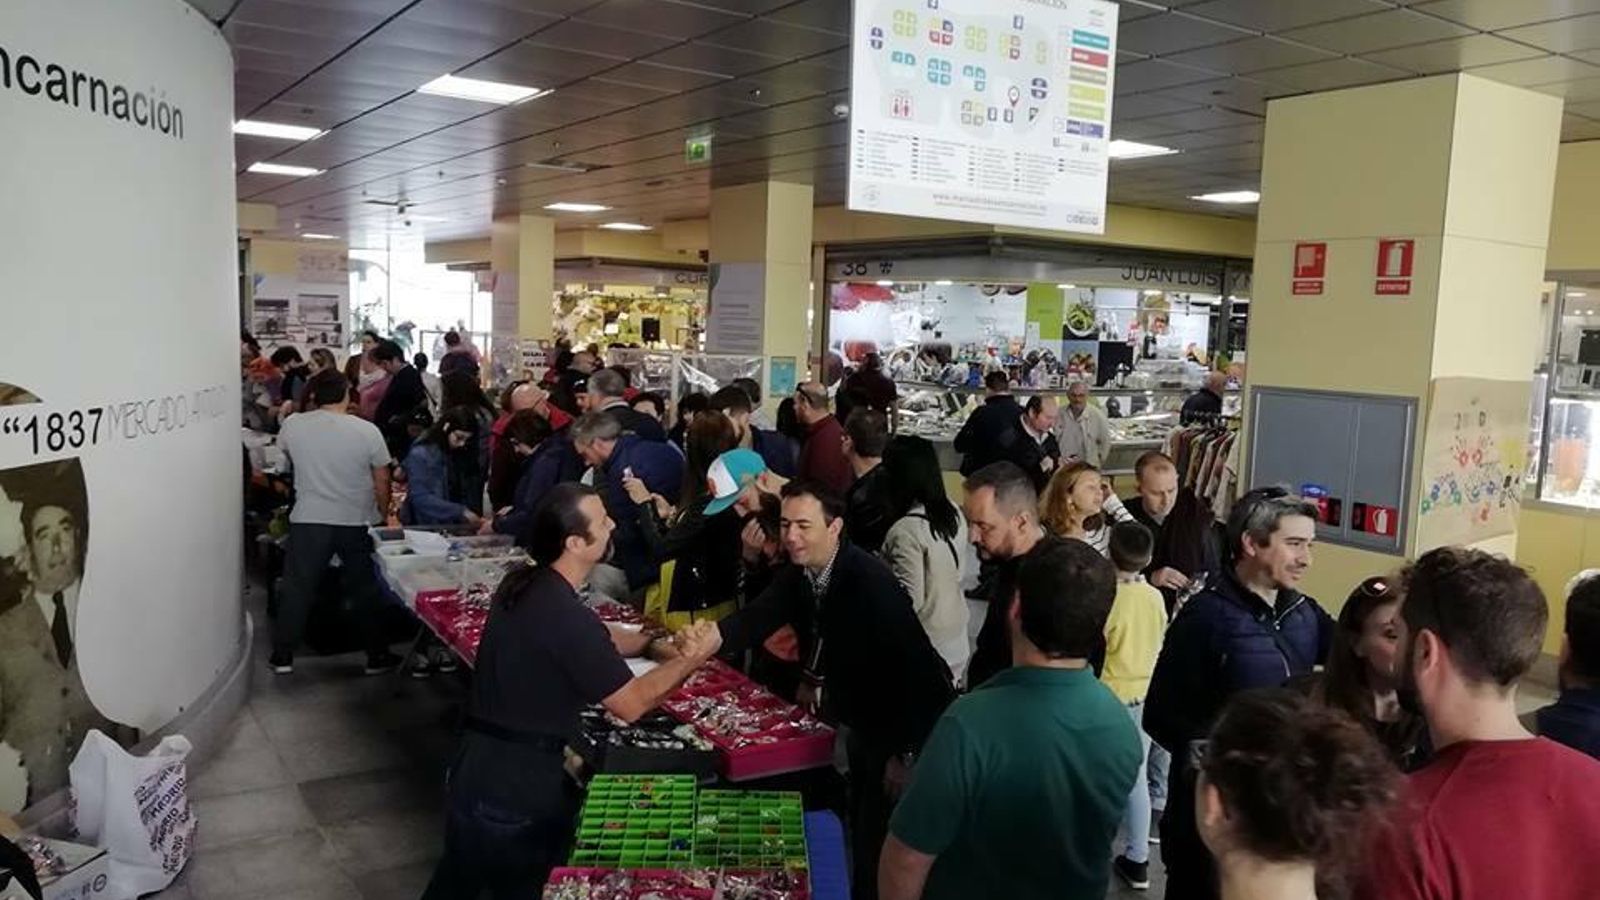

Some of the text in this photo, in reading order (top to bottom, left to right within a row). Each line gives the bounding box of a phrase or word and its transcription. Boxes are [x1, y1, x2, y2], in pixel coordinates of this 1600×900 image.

[1120, 264, 1173, 284] JUAN
[1177, 268, 1218, 288] LUIS
[107, 395, 188, 441] MERCADO
[150, 777, 186, 819] MADRID
